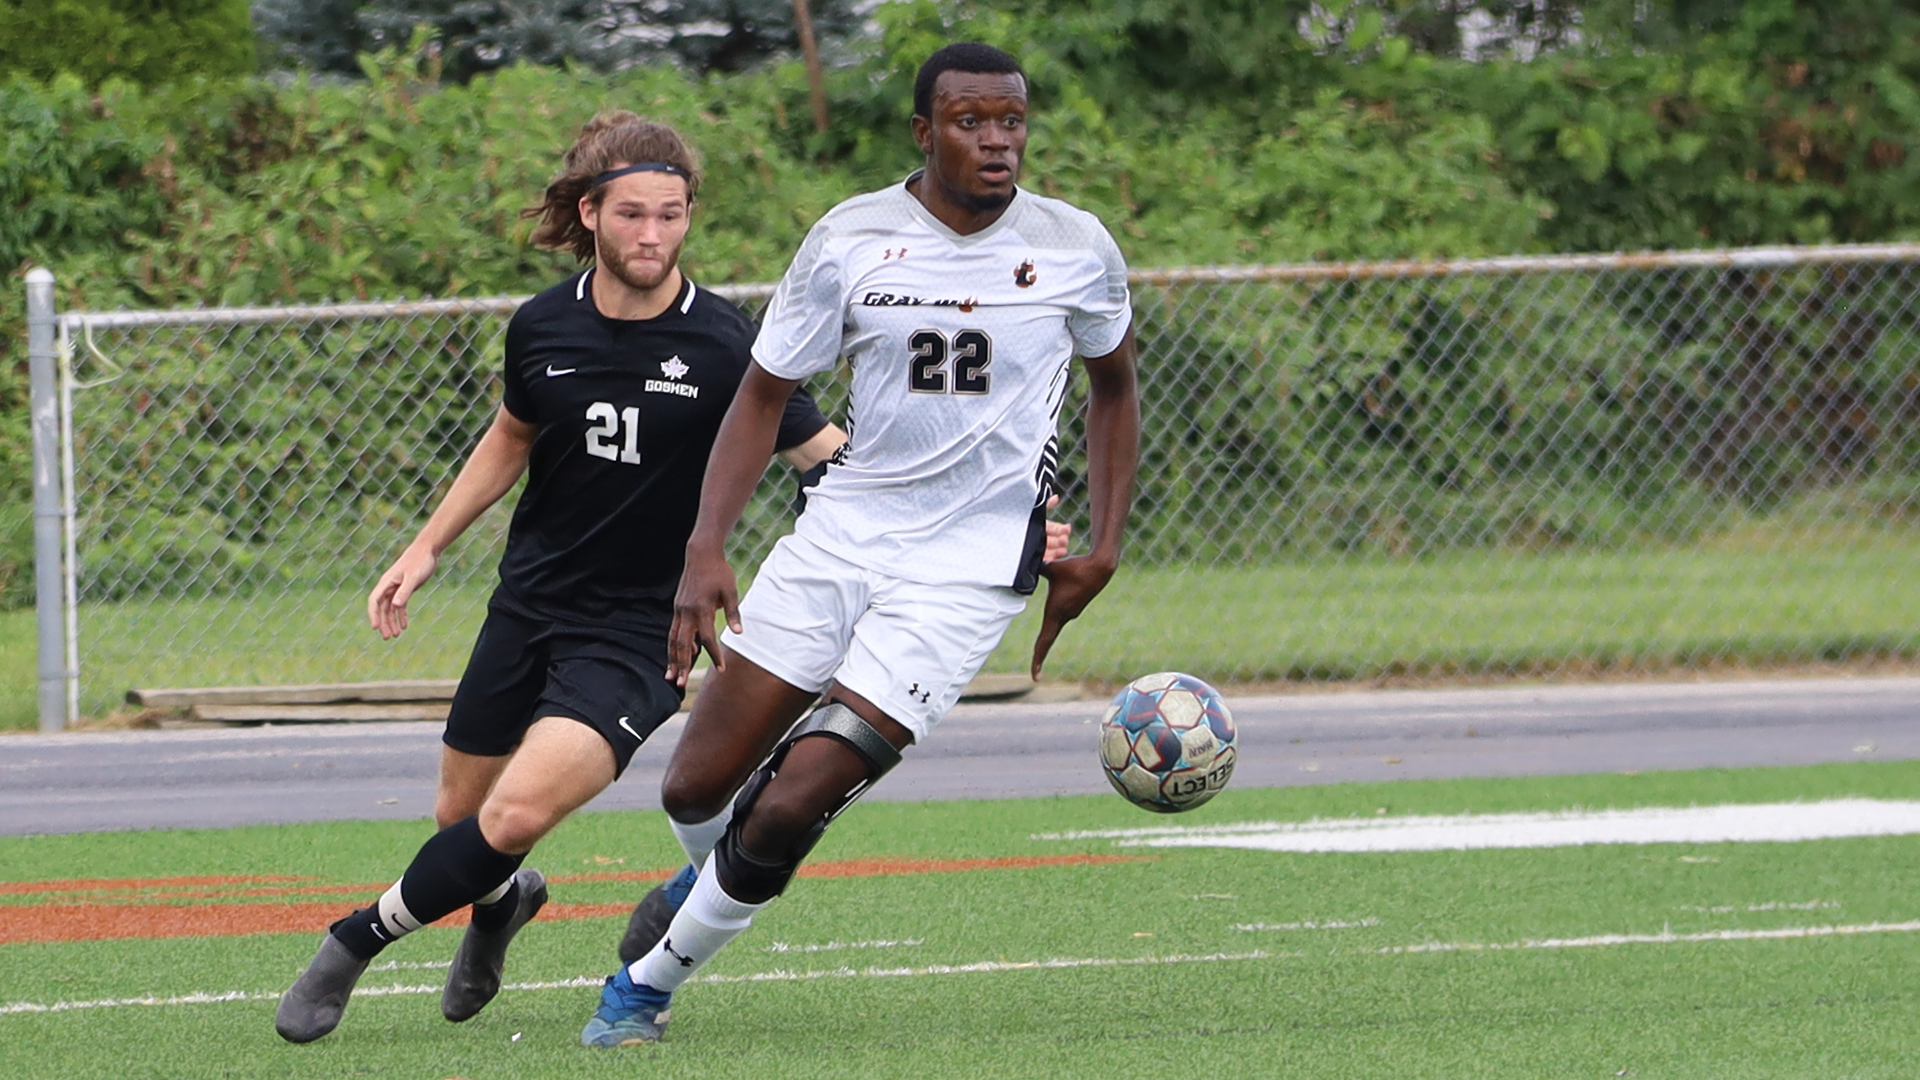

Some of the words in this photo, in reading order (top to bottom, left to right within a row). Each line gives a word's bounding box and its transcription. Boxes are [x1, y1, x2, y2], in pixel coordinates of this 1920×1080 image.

[908, 328, 992, 394] 22
[645, 379, 699, 398] GOSHEN
[585, 402, 641, 464] 21
[1171, 755, 1234, 797] SELECT
